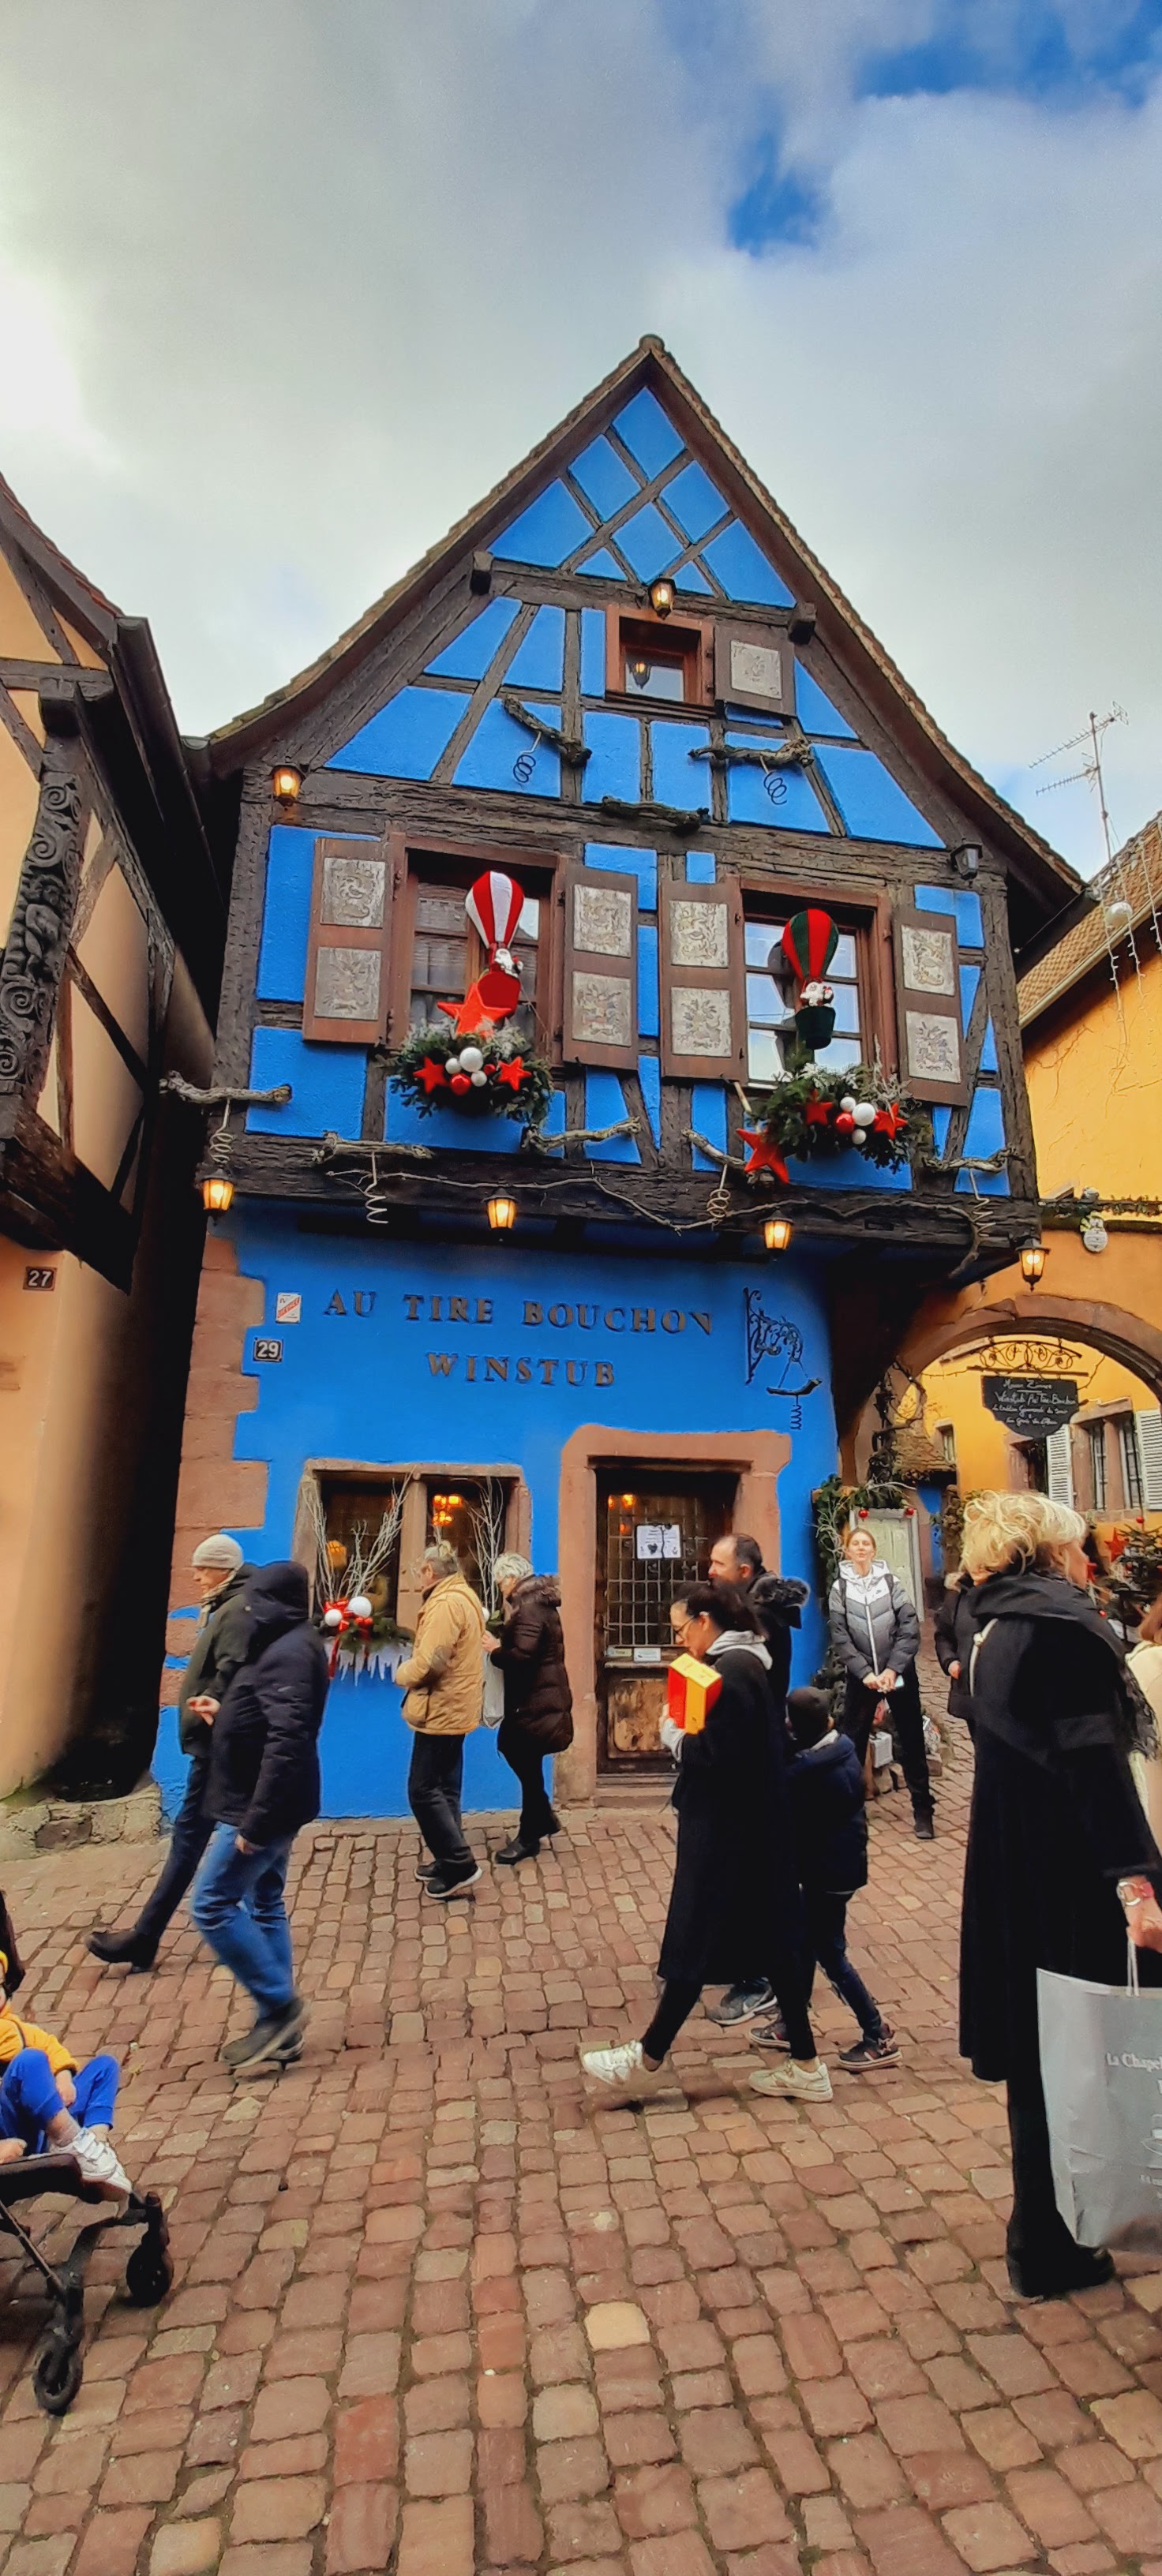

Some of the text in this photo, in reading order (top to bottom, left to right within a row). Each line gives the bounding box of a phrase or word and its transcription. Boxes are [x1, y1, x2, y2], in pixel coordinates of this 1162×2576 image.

[28, 1270, 52, 1287] 27
[324, 1288, 376, 1317] AU
[403, 1294, 493, 1324] TIRE
[521, 1300, 712, 1335] BOUCHON
[257, 1341, 279, 1358] 29
[426, 1352, 614, 1387] WINSTUB
